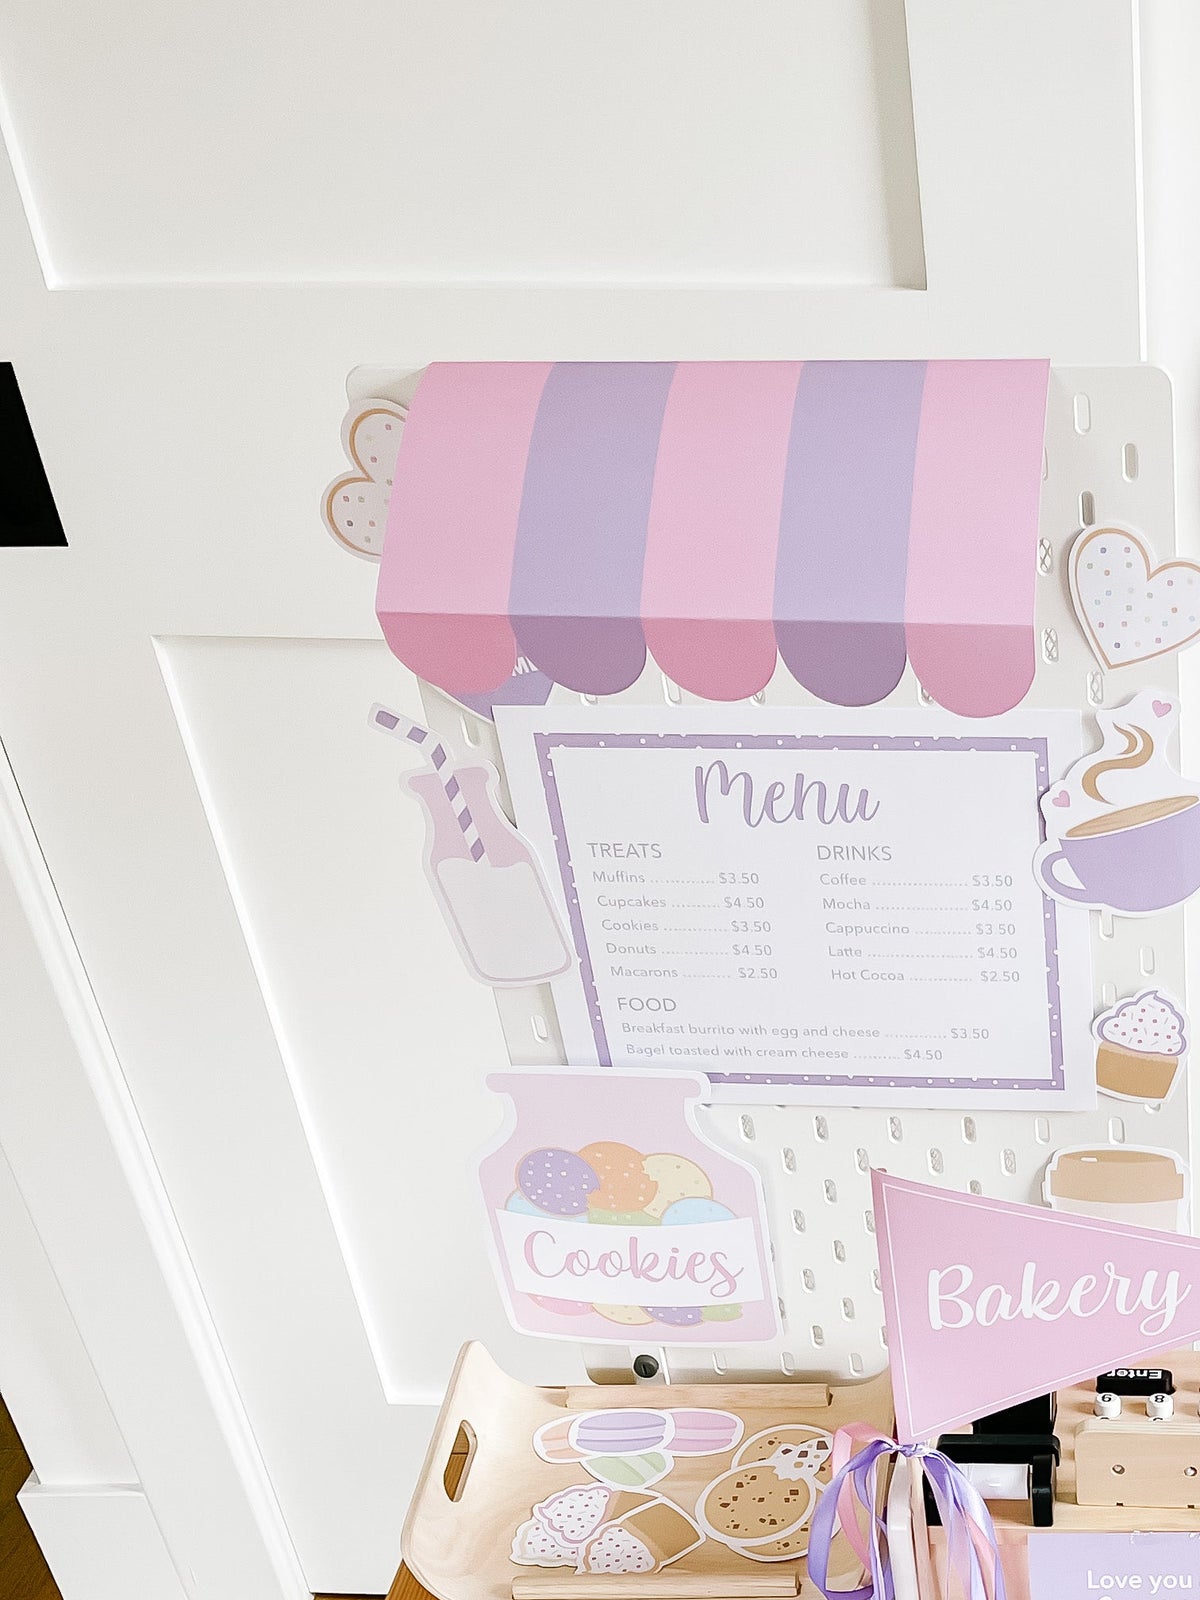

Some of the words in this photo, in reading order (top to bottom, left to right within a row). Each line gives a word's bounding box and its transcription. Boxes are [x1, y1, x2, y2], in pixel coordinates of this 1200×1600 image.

[695, 760, 880, 828] Menu
[586, 842, 663, 859] TREATS
[816, 845, 893, 861] DRINKS
[592, 871, 646, 884] Muffins
[718, 872, 760, 885] $3.50
[819, 873, 867, 886] Coffee
[971, 875, 1013, 887] $3.50
[597, 895, 667, 910] Cupcakes
[723, 896, 765, 910] $4.50
[822, 898, 871, 910] Mocha
[971, 899, 1013, 911] $4.50
[601, 919, 659, 931] Cookies
[730, 920, 772, 933] $3.50
[825, 922, 910, 937] Cappuccino
[975, 923, 1016, 936] $3.50
[605, 943, 657, 955] Donuts
[732, 944, 773, 957] $4.50
[828, 946, 863, 958] Latte
[977, 947, 1018, 959] $4.50
[610, 966, 679, 978] Macarons
[738, 967, 778, 980] $2.50
[831, 969, 857, 981] Hot
[860, 969, 905, 981] Cocoa
[980, 970, 1020, 983] $2.50
[617, 997, 677, 1012] FOOD
[621, 1022, 685, 1036] Breakfast
[688, 1025, 735, 1036] burrito
[738, 1025, 768, 1037] with
[771, 1029, 799, 1040] egg
[802, 1027, 829, 1038] and
[832, 1027, 881, 1039] cheese
[950, 1028, 990, 1041] $3.50
[626, 1043, 666, 1058] Bagel
[669, 1045, 720, 1057] toasted
[723, 1046, 752, 1058] with
[756, 1049, 798, 1059] cream
[801, 1048, 850, 1060] cheese
[903, 1049, 943, 1061] $4.50
[523, 1230, 744, 1298] Cookies
[927, 1261, 1193, 1337] Bakery
[1087, 1570, 1143, 1589] Love
[1150, 1574, 1193, 1594] you
